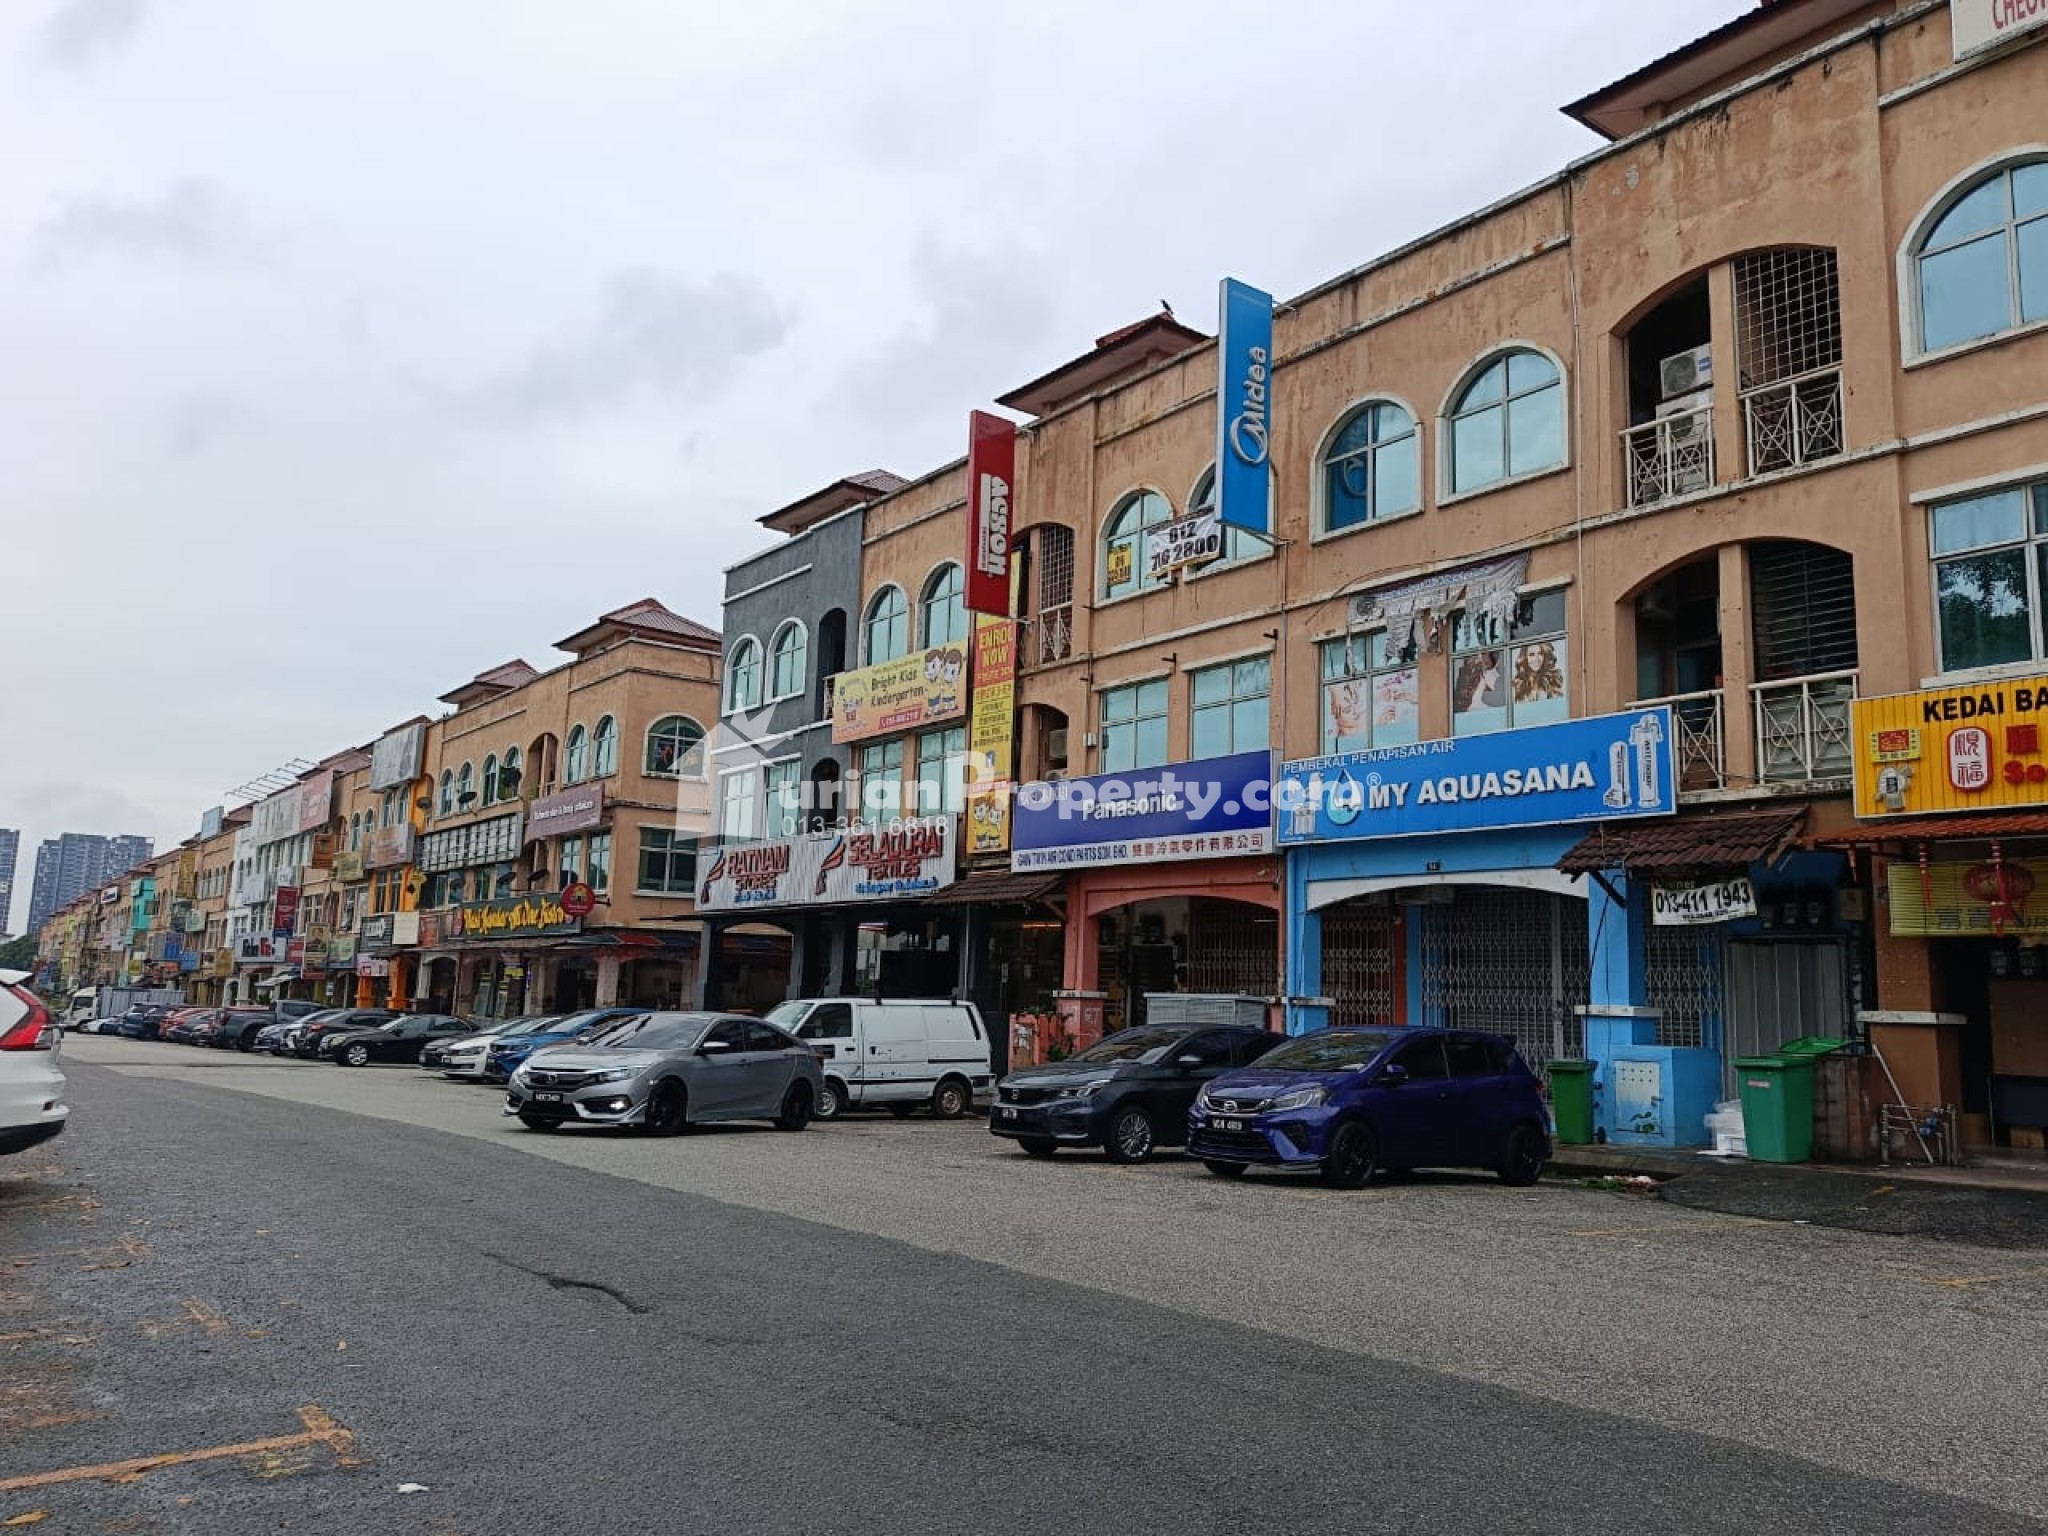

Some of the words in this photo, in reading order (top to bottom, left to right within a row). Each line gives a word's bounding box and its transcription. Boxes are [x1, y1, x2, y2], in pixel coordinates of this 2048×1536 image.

[1240, 346, 1267, 452] Midea
[983, 645, 1008, 667] NOW
[1923, 691, 2004, 722] KEDAI
[1284, 759, 1348, 774] PEMBEKAL
[1352, 745, 1427, 764] PENAPISAN
[1430, 740, 1456, 754] AIR
[1369, 782, 1409, 809] MY
[1417, 761, 1596, 804] AQUASANA
[1083, 788, 1177, 821] Panasonic
[728, 845, 790, 876] RATNAM
[1655, 890, 1708, 914] 013-411
[1714, 881, 1751, 909] 1943
